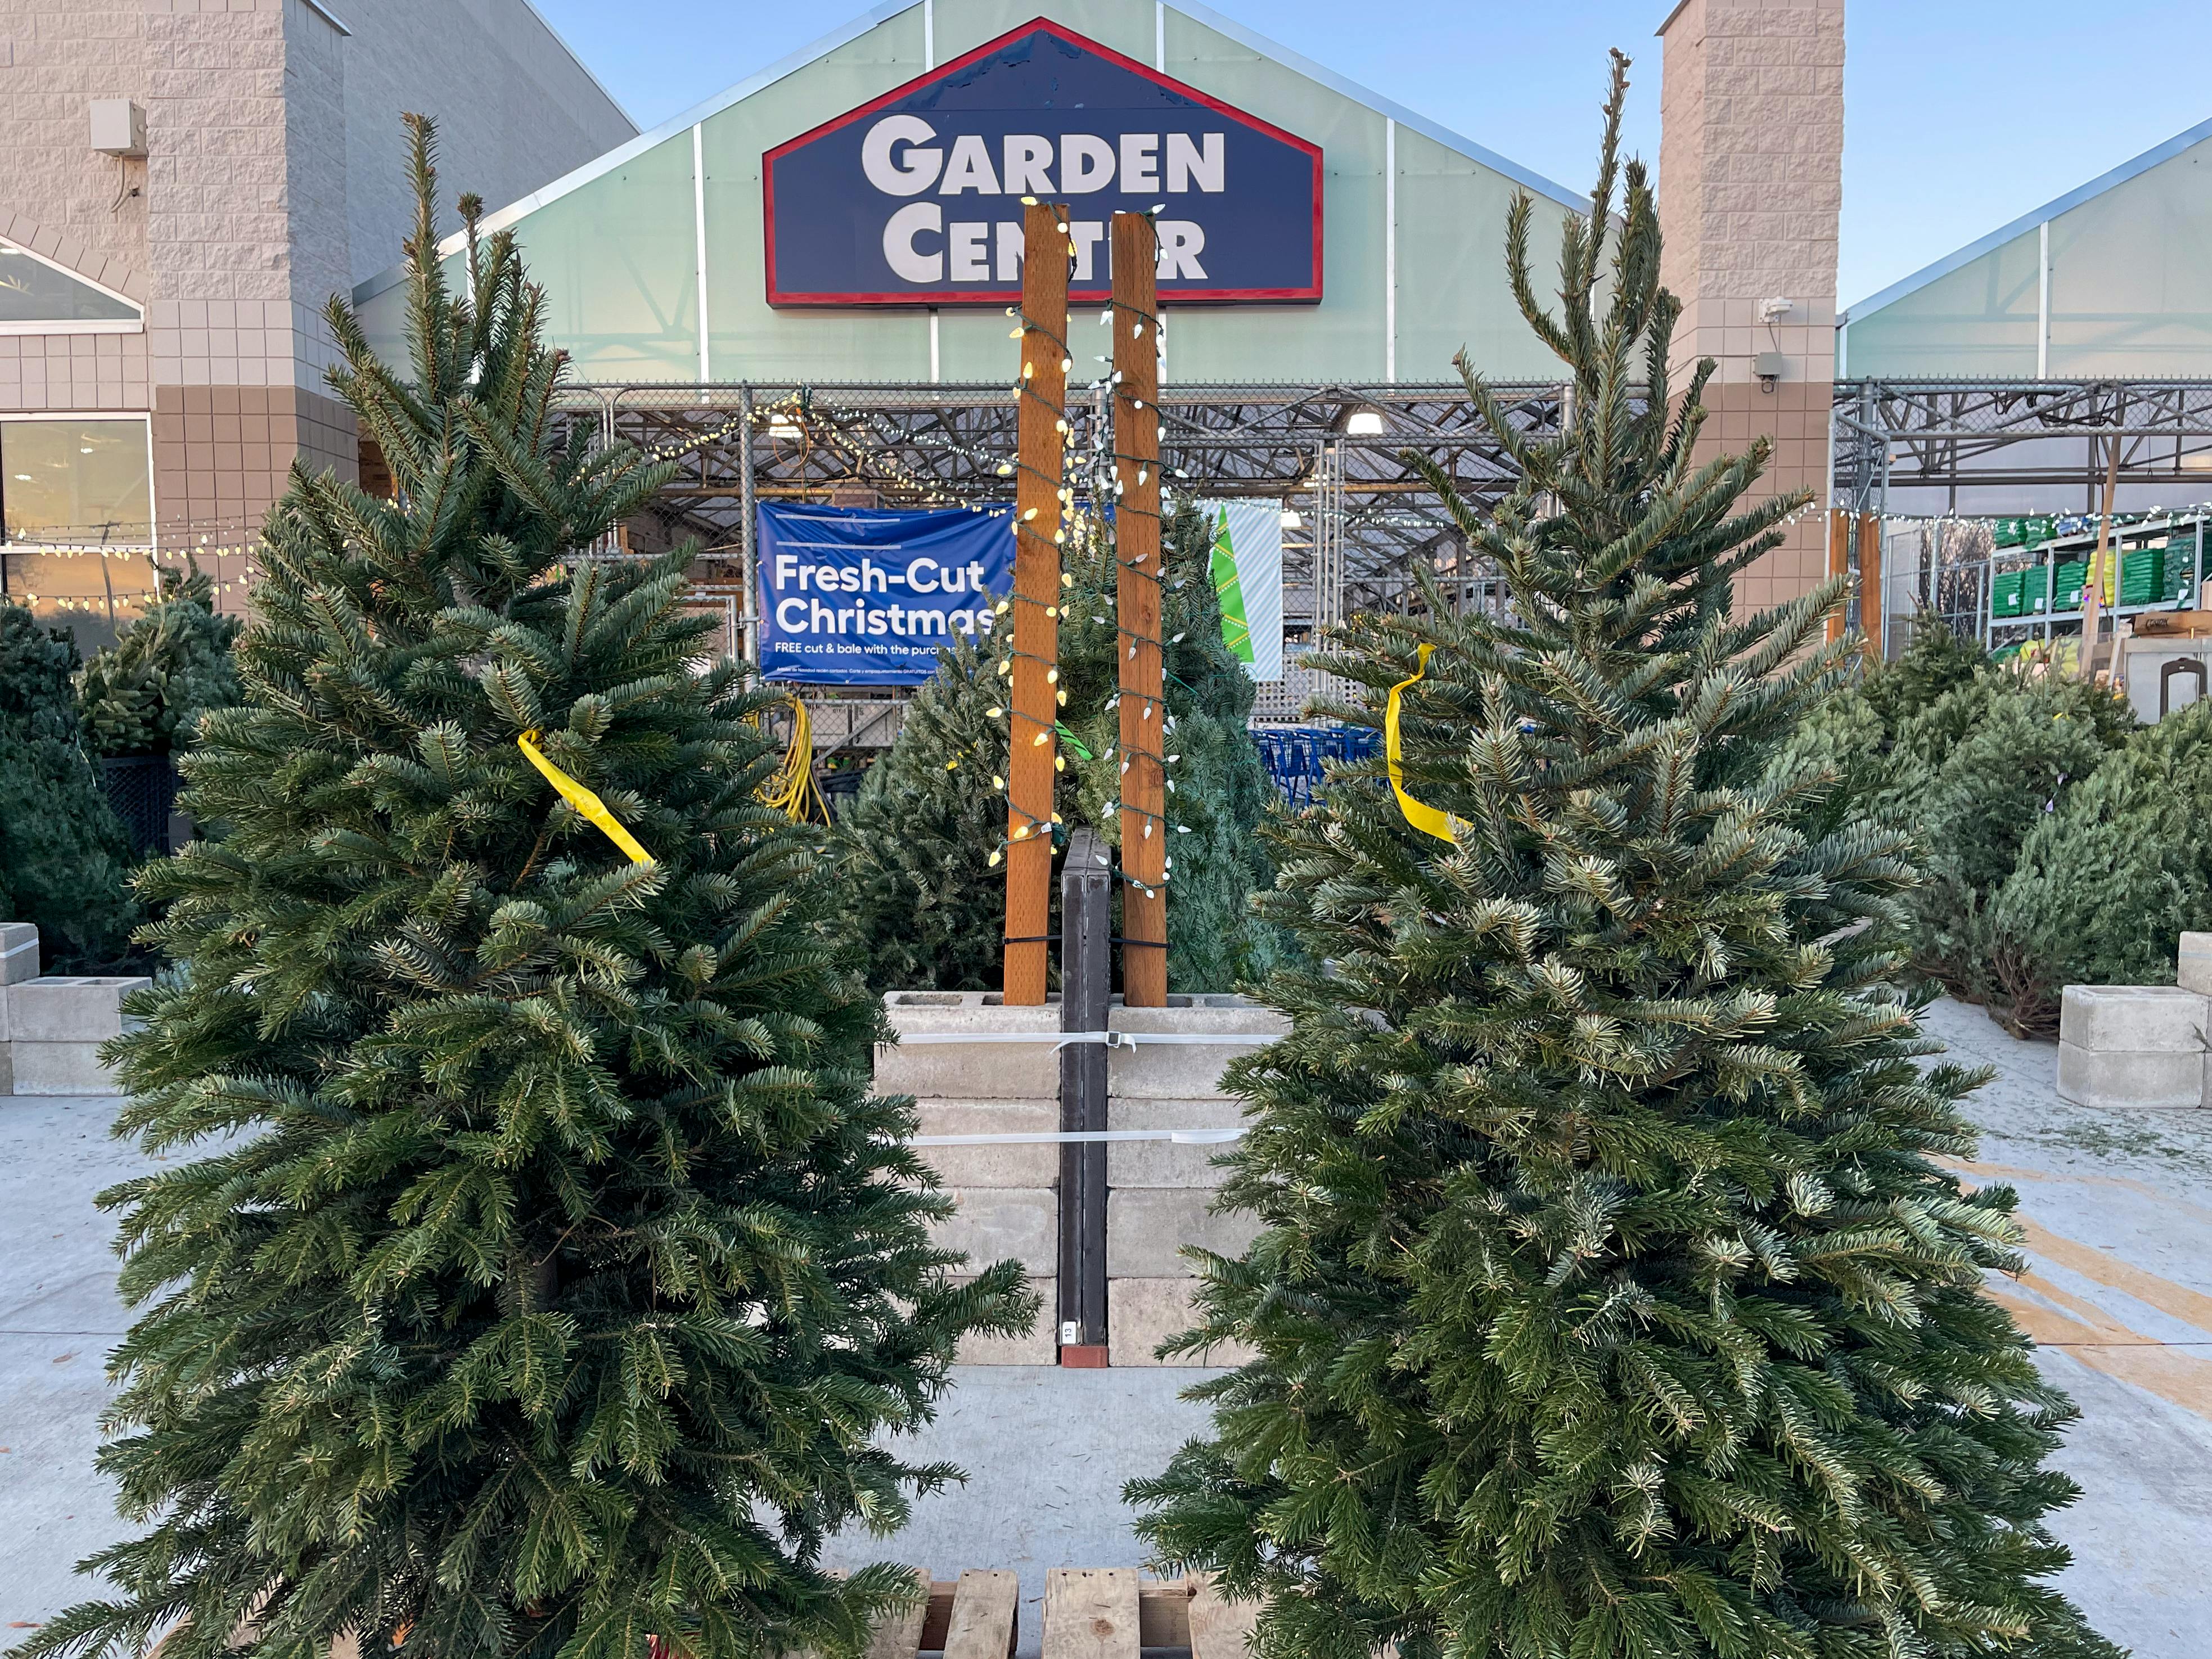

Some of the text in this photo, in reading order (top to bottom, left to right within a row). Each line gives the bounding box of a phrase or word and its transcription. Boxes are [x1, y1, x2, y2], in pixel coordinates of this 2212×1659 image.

[862, 114, 1225, 196] GARDEN
[883, 201, 1209, 282] CENTR
[776, 554, 985, 593] Fresh-Cut
[776, 597, 995, 635] Christmas
[775, 642, 802, 653] FREE
[804, 643, 823, 653] cut
[826, 643, 835, 653] &
[837, 643, 862, 654] bale
[864, 644, 887, 654] with
[890, 644, 909, 655] the
[1065, 1328, 1071, 1337] 13
